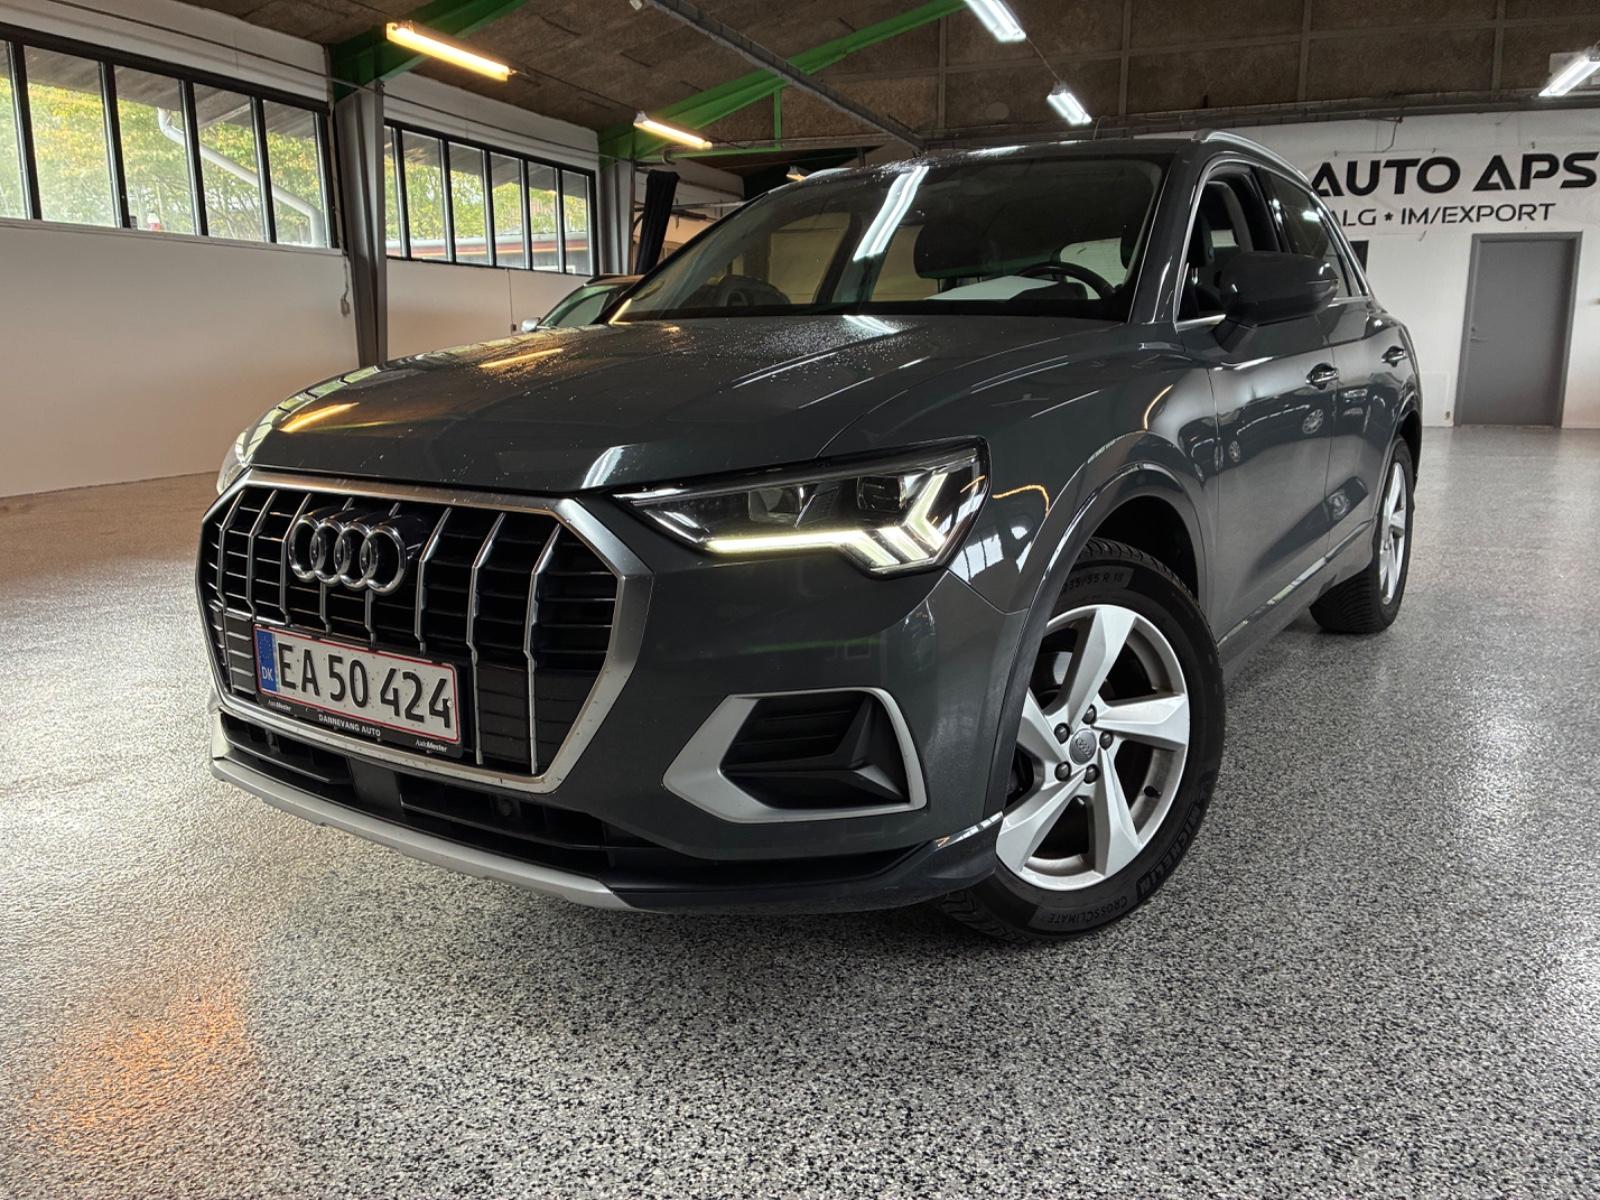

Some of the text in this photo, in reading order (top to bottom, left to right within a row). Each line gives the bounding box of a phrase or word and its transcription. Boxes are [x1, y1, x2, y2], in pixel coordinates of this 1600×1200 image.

[1312, 151, 1600, 197] AUTO APS
[1401, 203, 1557, 225] IM/EXPORT
[261, 666, 274, 682] DK
[277, 642, 450, 729] EA 50 424
[361, 725, 381, 738] AUTO
[1138, 802, 1202, 896] MICHELIN
[1047, 895, 1129, 925] CROSSCLIMATE
